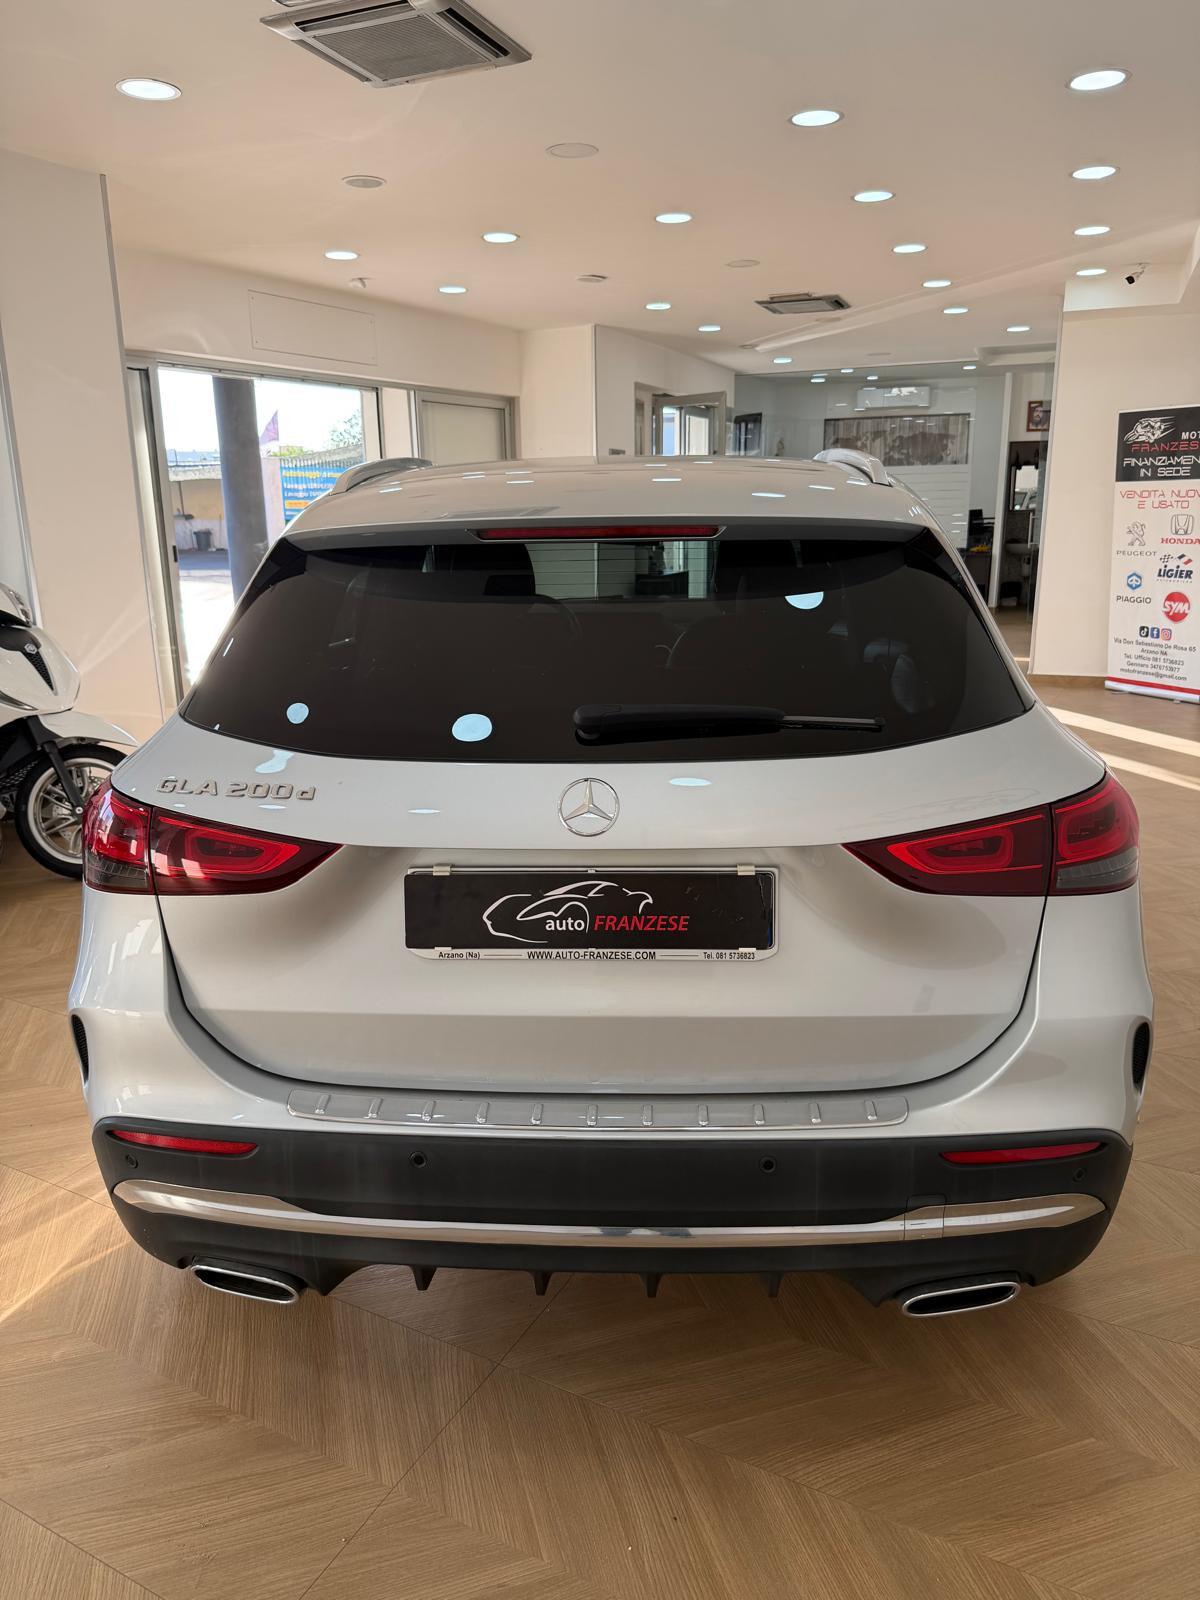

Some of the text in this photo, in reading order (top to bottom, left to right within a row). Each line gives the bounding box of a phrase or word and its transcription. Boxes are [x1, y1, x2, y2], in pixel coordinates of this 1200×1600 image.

[1140, 467, 1191, 477] IN SEDE
[1120, 490, 1165, 498] VENDITA
[1138, 500, 1189, 509] E USATO
[1116, 596, 1152, 604] PIAGGIO
[1162, 601, 1190, 616] SYM
[156, 779, 218, 796] GLA
[545, 915, 690, 931] auto FRANZESE
[527, 951, 656, 960] WWW.AUTO-FRANZESE.COM
[716, 952, 727, 960] 081
[729, 952, 755, 960] 5736823
